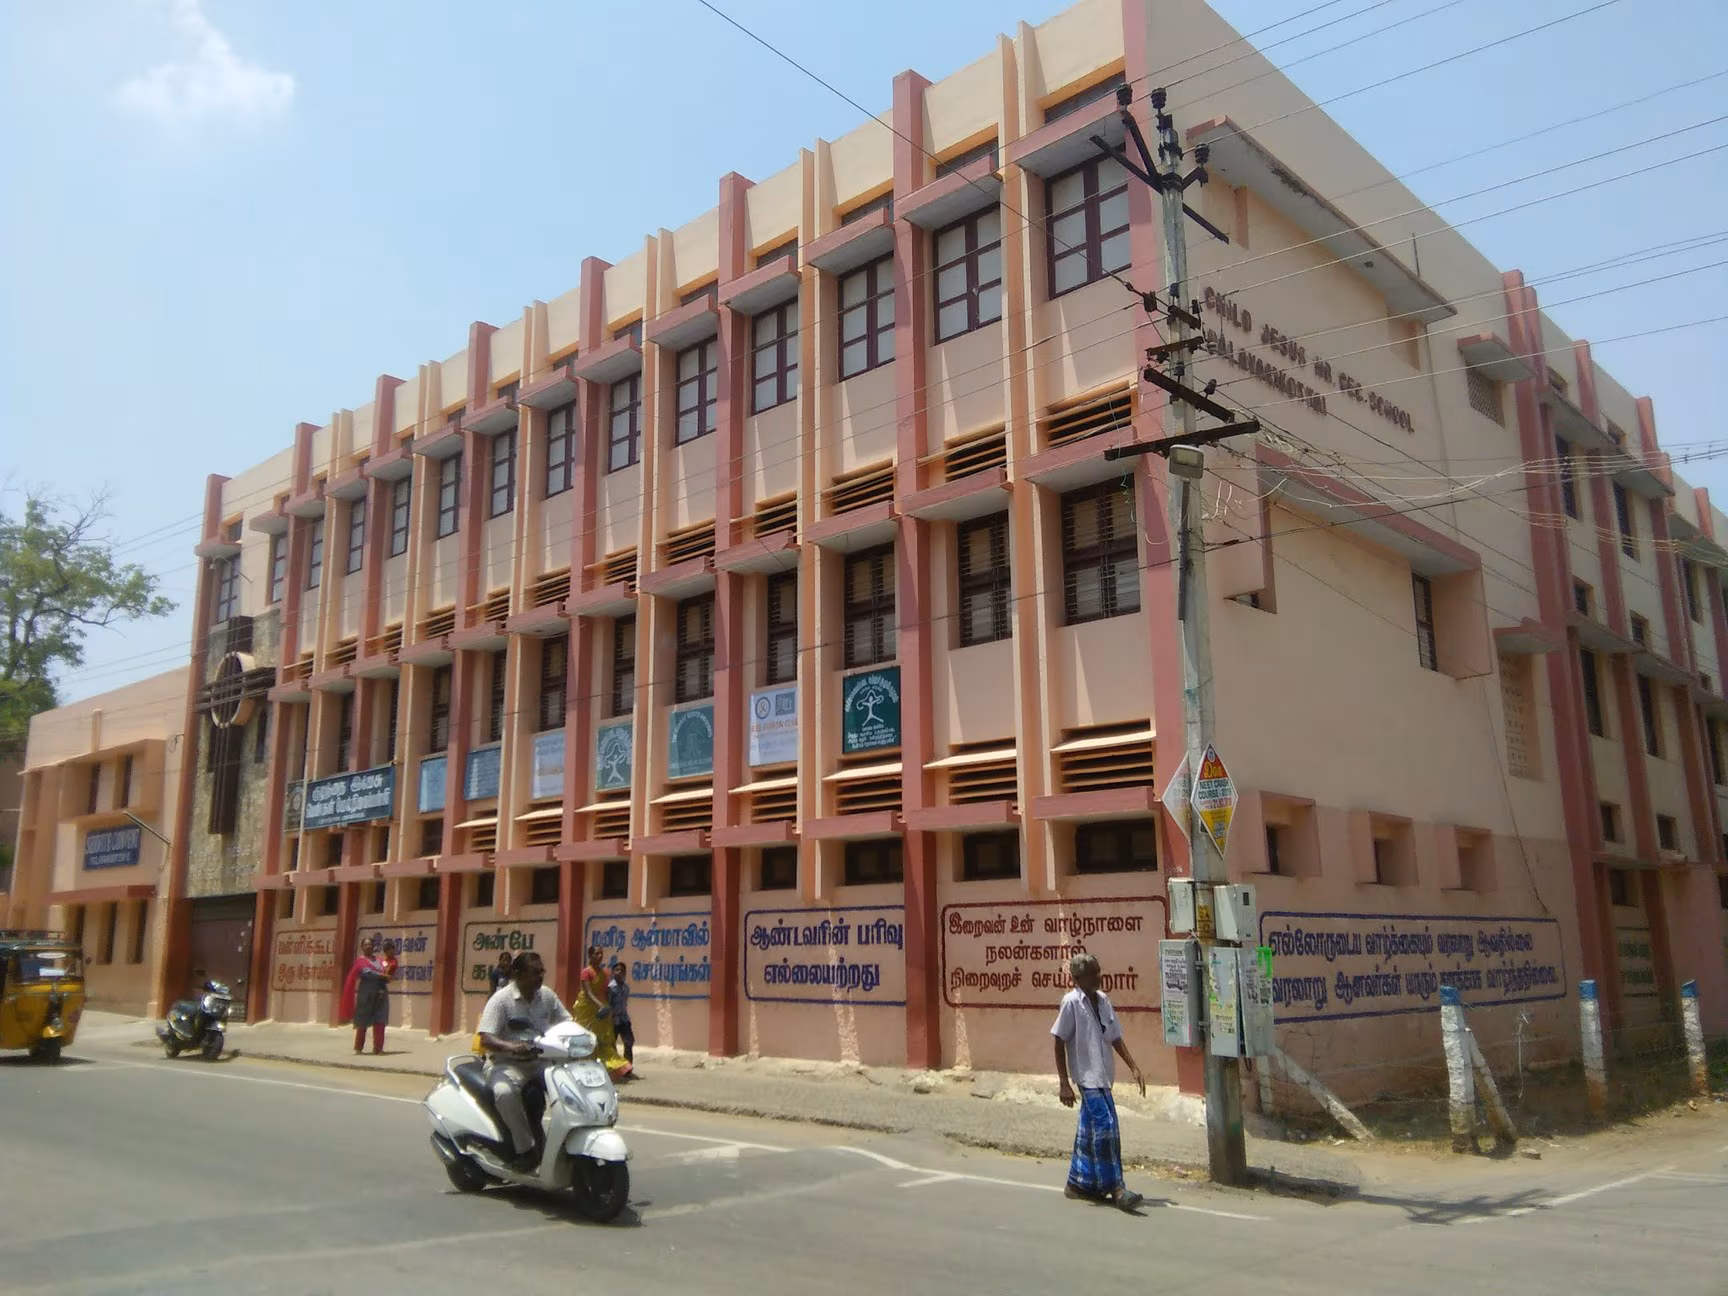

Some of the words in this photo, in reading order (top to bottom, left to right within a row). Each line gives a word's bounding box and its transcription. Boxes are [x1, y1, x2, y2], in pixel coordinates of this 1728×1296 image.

[472, 928, 535, 950] அன்பே
[591, 925, 626, 951] மனித
[631, 921, 710, 951] ஆன்மாவில்
[751, 918, 850, 950] ஆண்டவரின்
[857, 918, 903, 950] பரிவு
[949, 912, 1006, 938] இறைவன்
[1010, 913, 1035, 934] உன்
[1044, 912, 1143, 938] வாழ்நாளை
[985, 939, 1087, 966] நலன்களால்
[1269, 924, 1361, 962] எல்லோருடைய
[764, 957, 880, 992] எல்லையற்றது
[950, 967, 1022, 993] நிறைவுறச்
[1272, 976, 1328, 1011] வரலாறு
[1335, 963, 1401, 1005] ஆனவர்கள்
